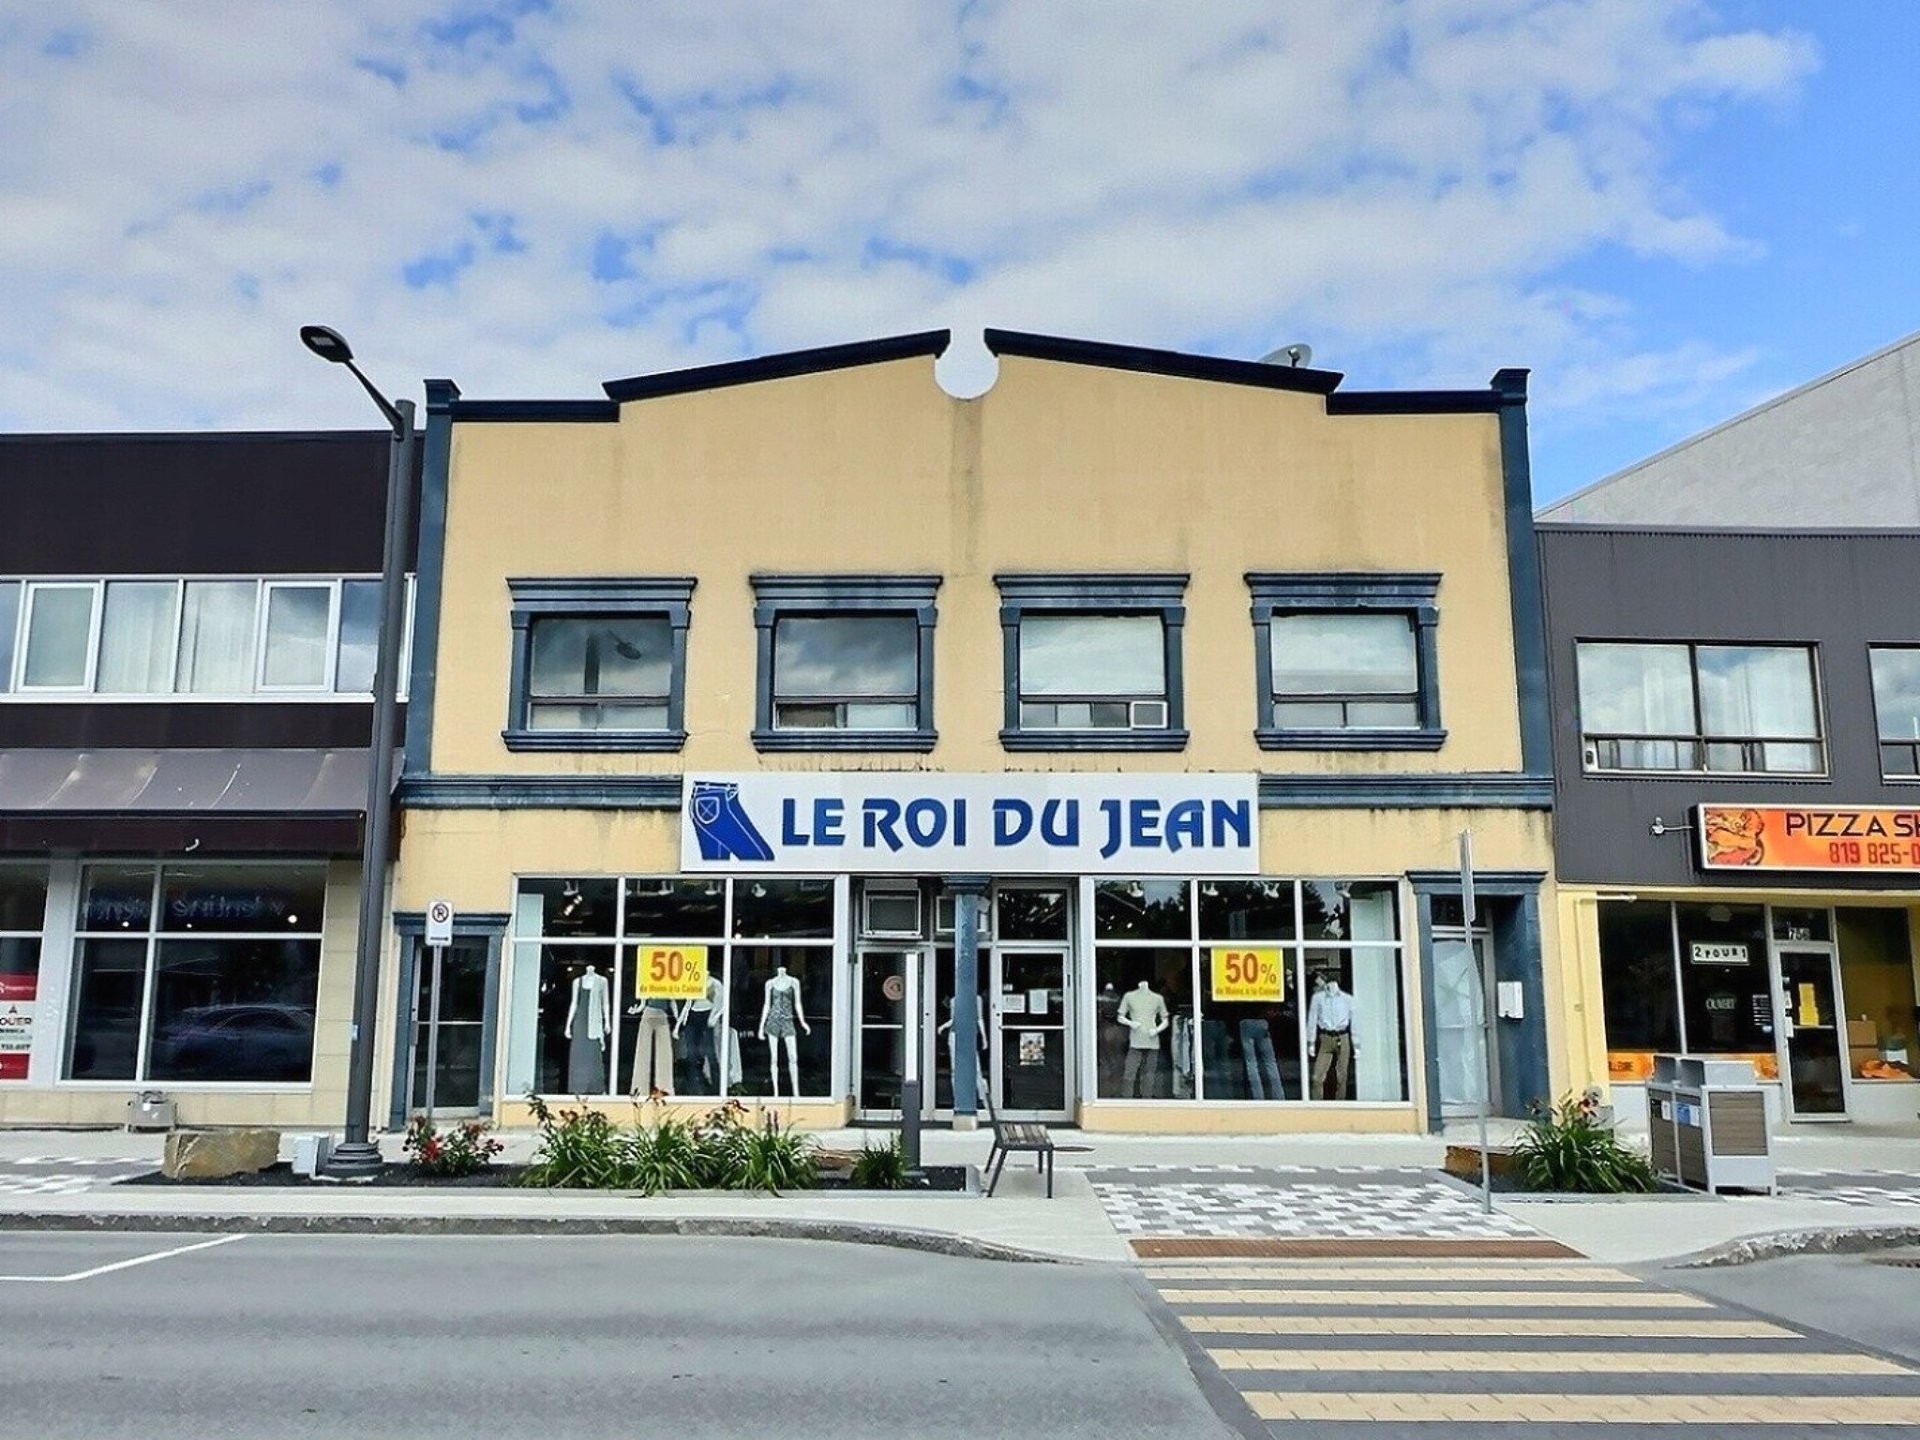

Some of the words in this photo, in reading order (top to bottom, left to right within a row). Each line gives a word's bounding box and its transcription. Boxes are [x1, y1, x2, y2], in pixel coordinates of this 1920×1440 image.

[782, 798, 845, 846] LE
[862, 798, 967, 853] ROI
[993, 798, 1080, 847] DU
[1100, 798, 1250, 859] JEAN
[1786, 813, 1888, 837] PIZZA
[1893, 813, 1920, 837] S
[1829, 842, 1860, 865] 819
[1694, 946, 1702, 957] 2
[650, 951, 701, 982] 50%
[1225, 953, 1277, 985] 50%
